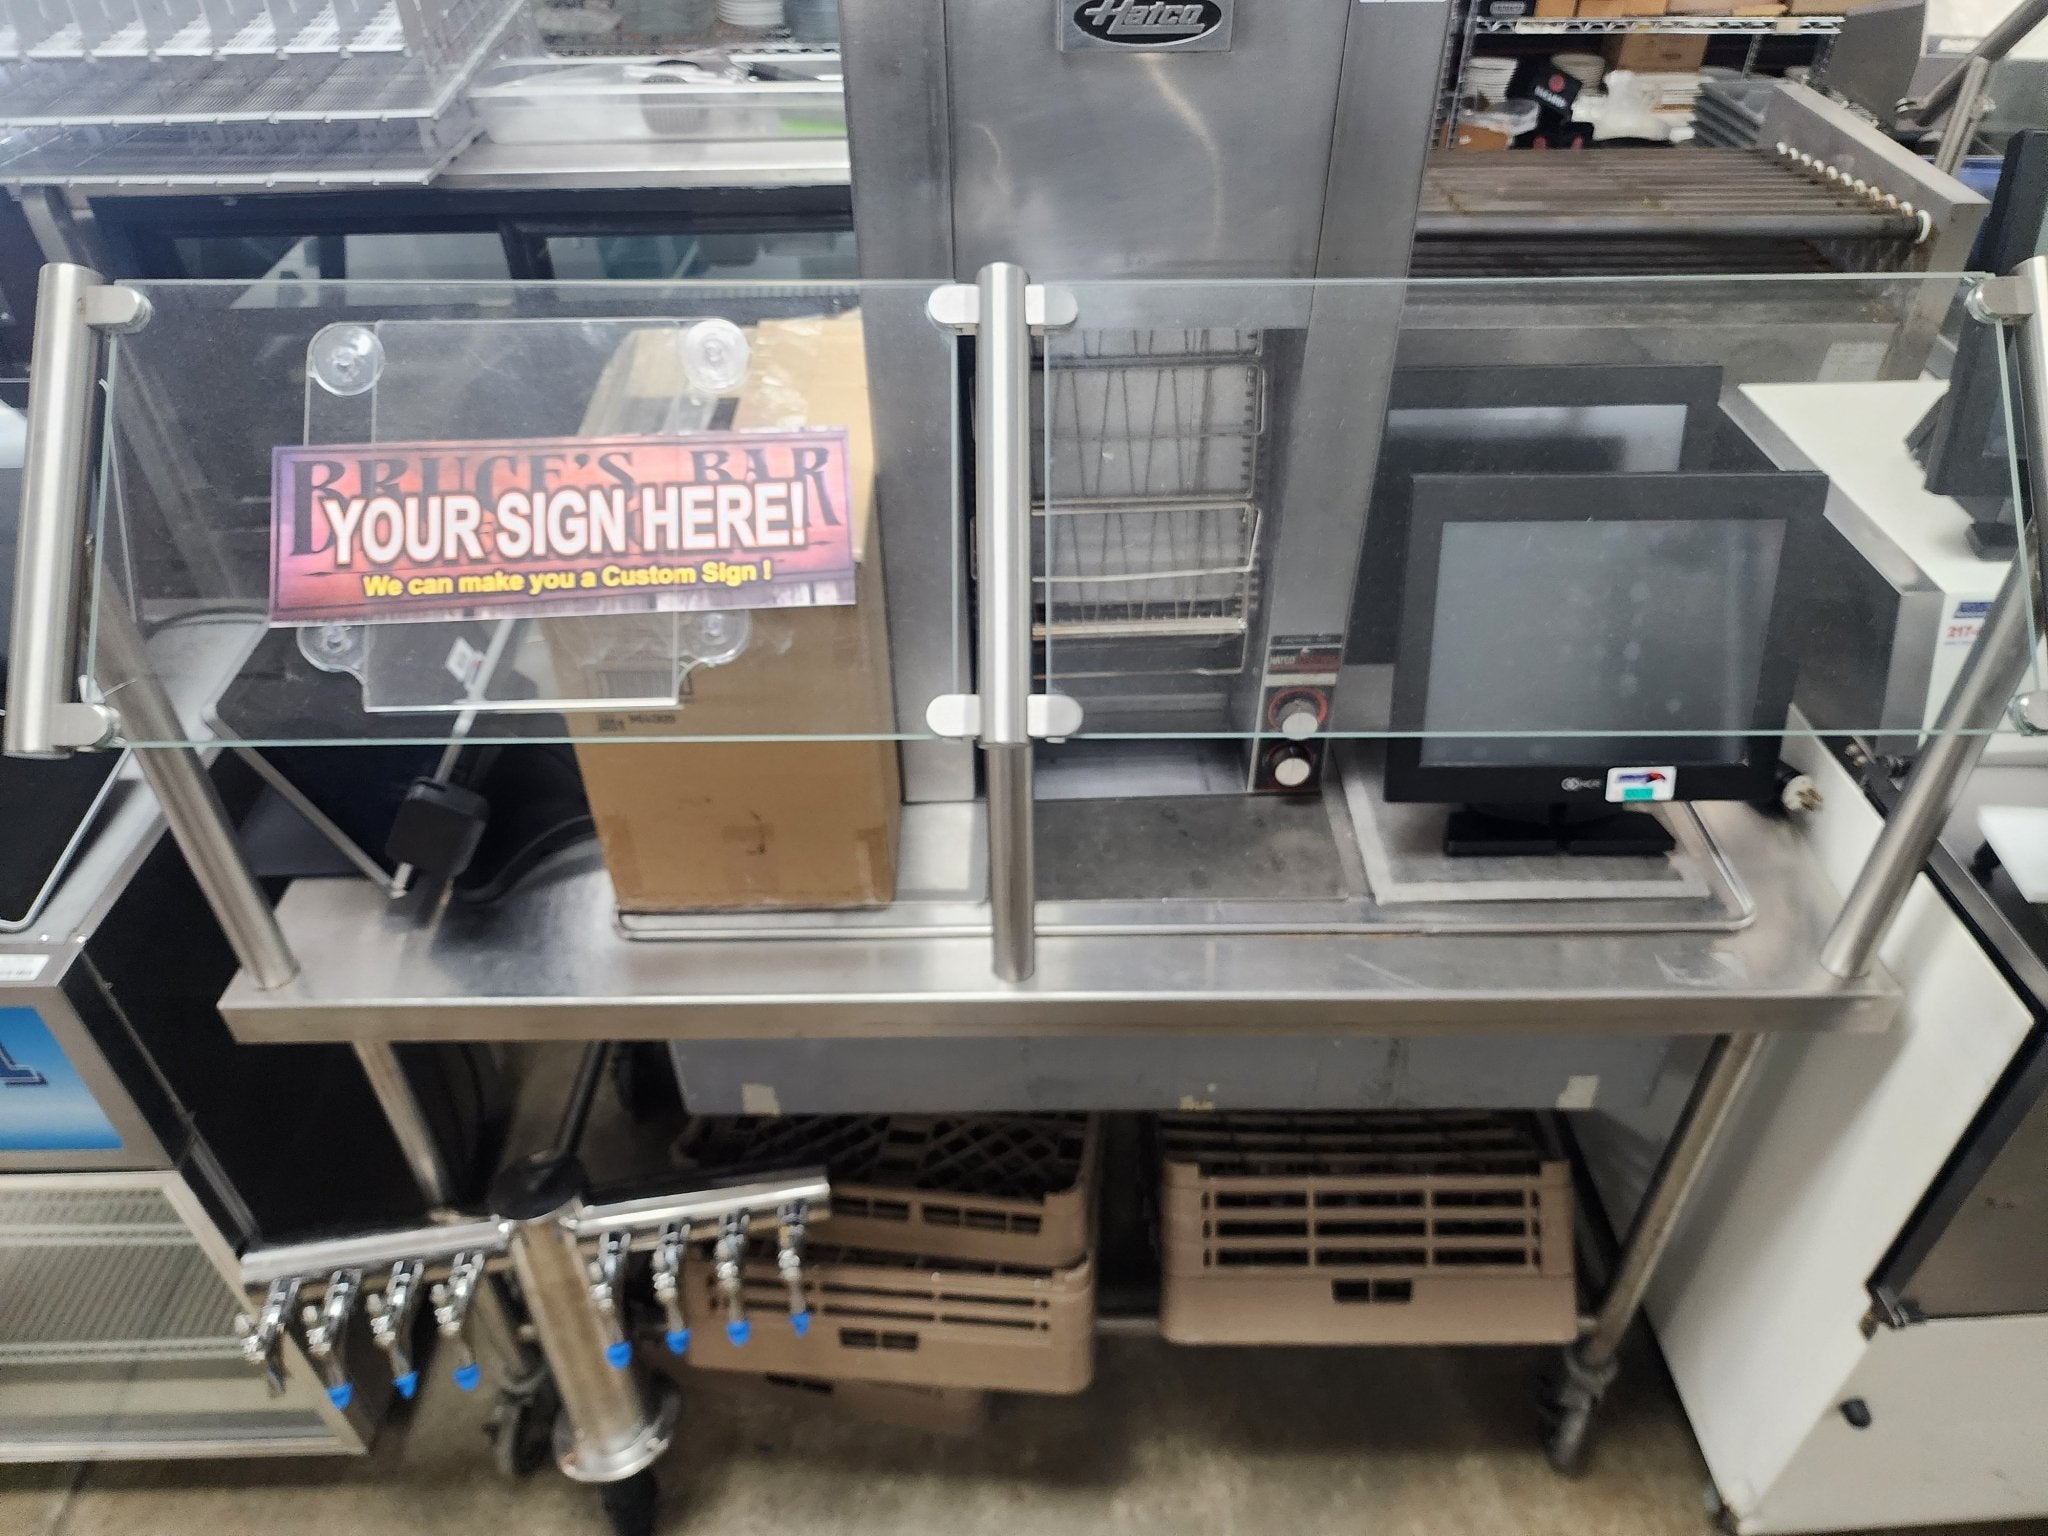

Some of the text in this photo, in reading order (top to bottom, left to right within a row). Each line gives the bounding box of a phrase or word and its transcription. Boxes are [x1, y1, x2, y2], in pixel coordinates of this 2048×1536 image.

[1084, 0, 1205, 35] Hatco
[320, 479, 808, 568] YOUR SIGN HERE!
[362, 573, 404, 597] We
[407, 575, 454, 596] can
[458, 569, 525, 594] make
[529, 572, 577, 596] you
[580, 569, 597, 588] a
[601, 562, 697, 587] Custom
[701, 558, 757, 588] Sign
